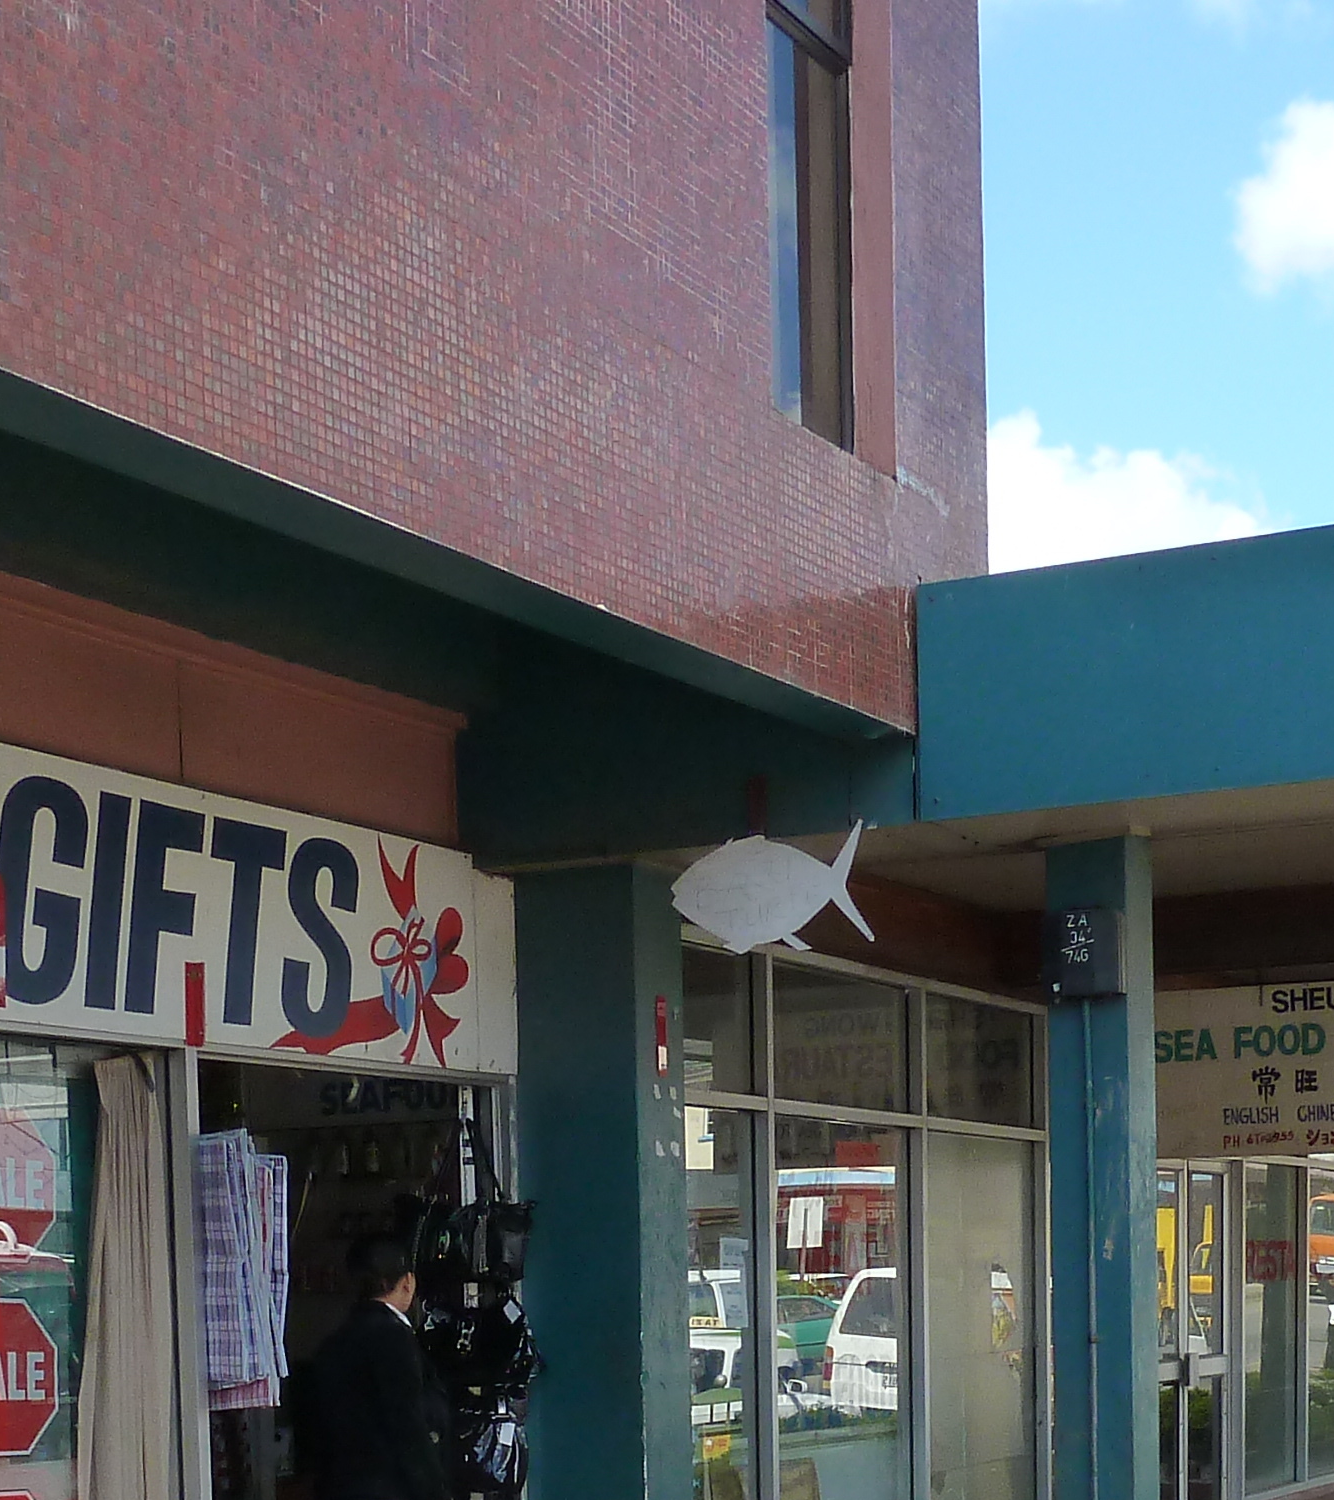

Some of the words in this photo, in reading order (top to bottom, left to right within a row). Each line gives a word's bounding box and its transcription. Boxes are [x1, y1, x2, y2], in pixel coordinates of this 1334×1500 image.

[1154, 1029, 1217, 1063] SEA
[1234, 1023, 1326, 1059] FOOD
[1223, 1106, 1280, 1125] ENGLISH
